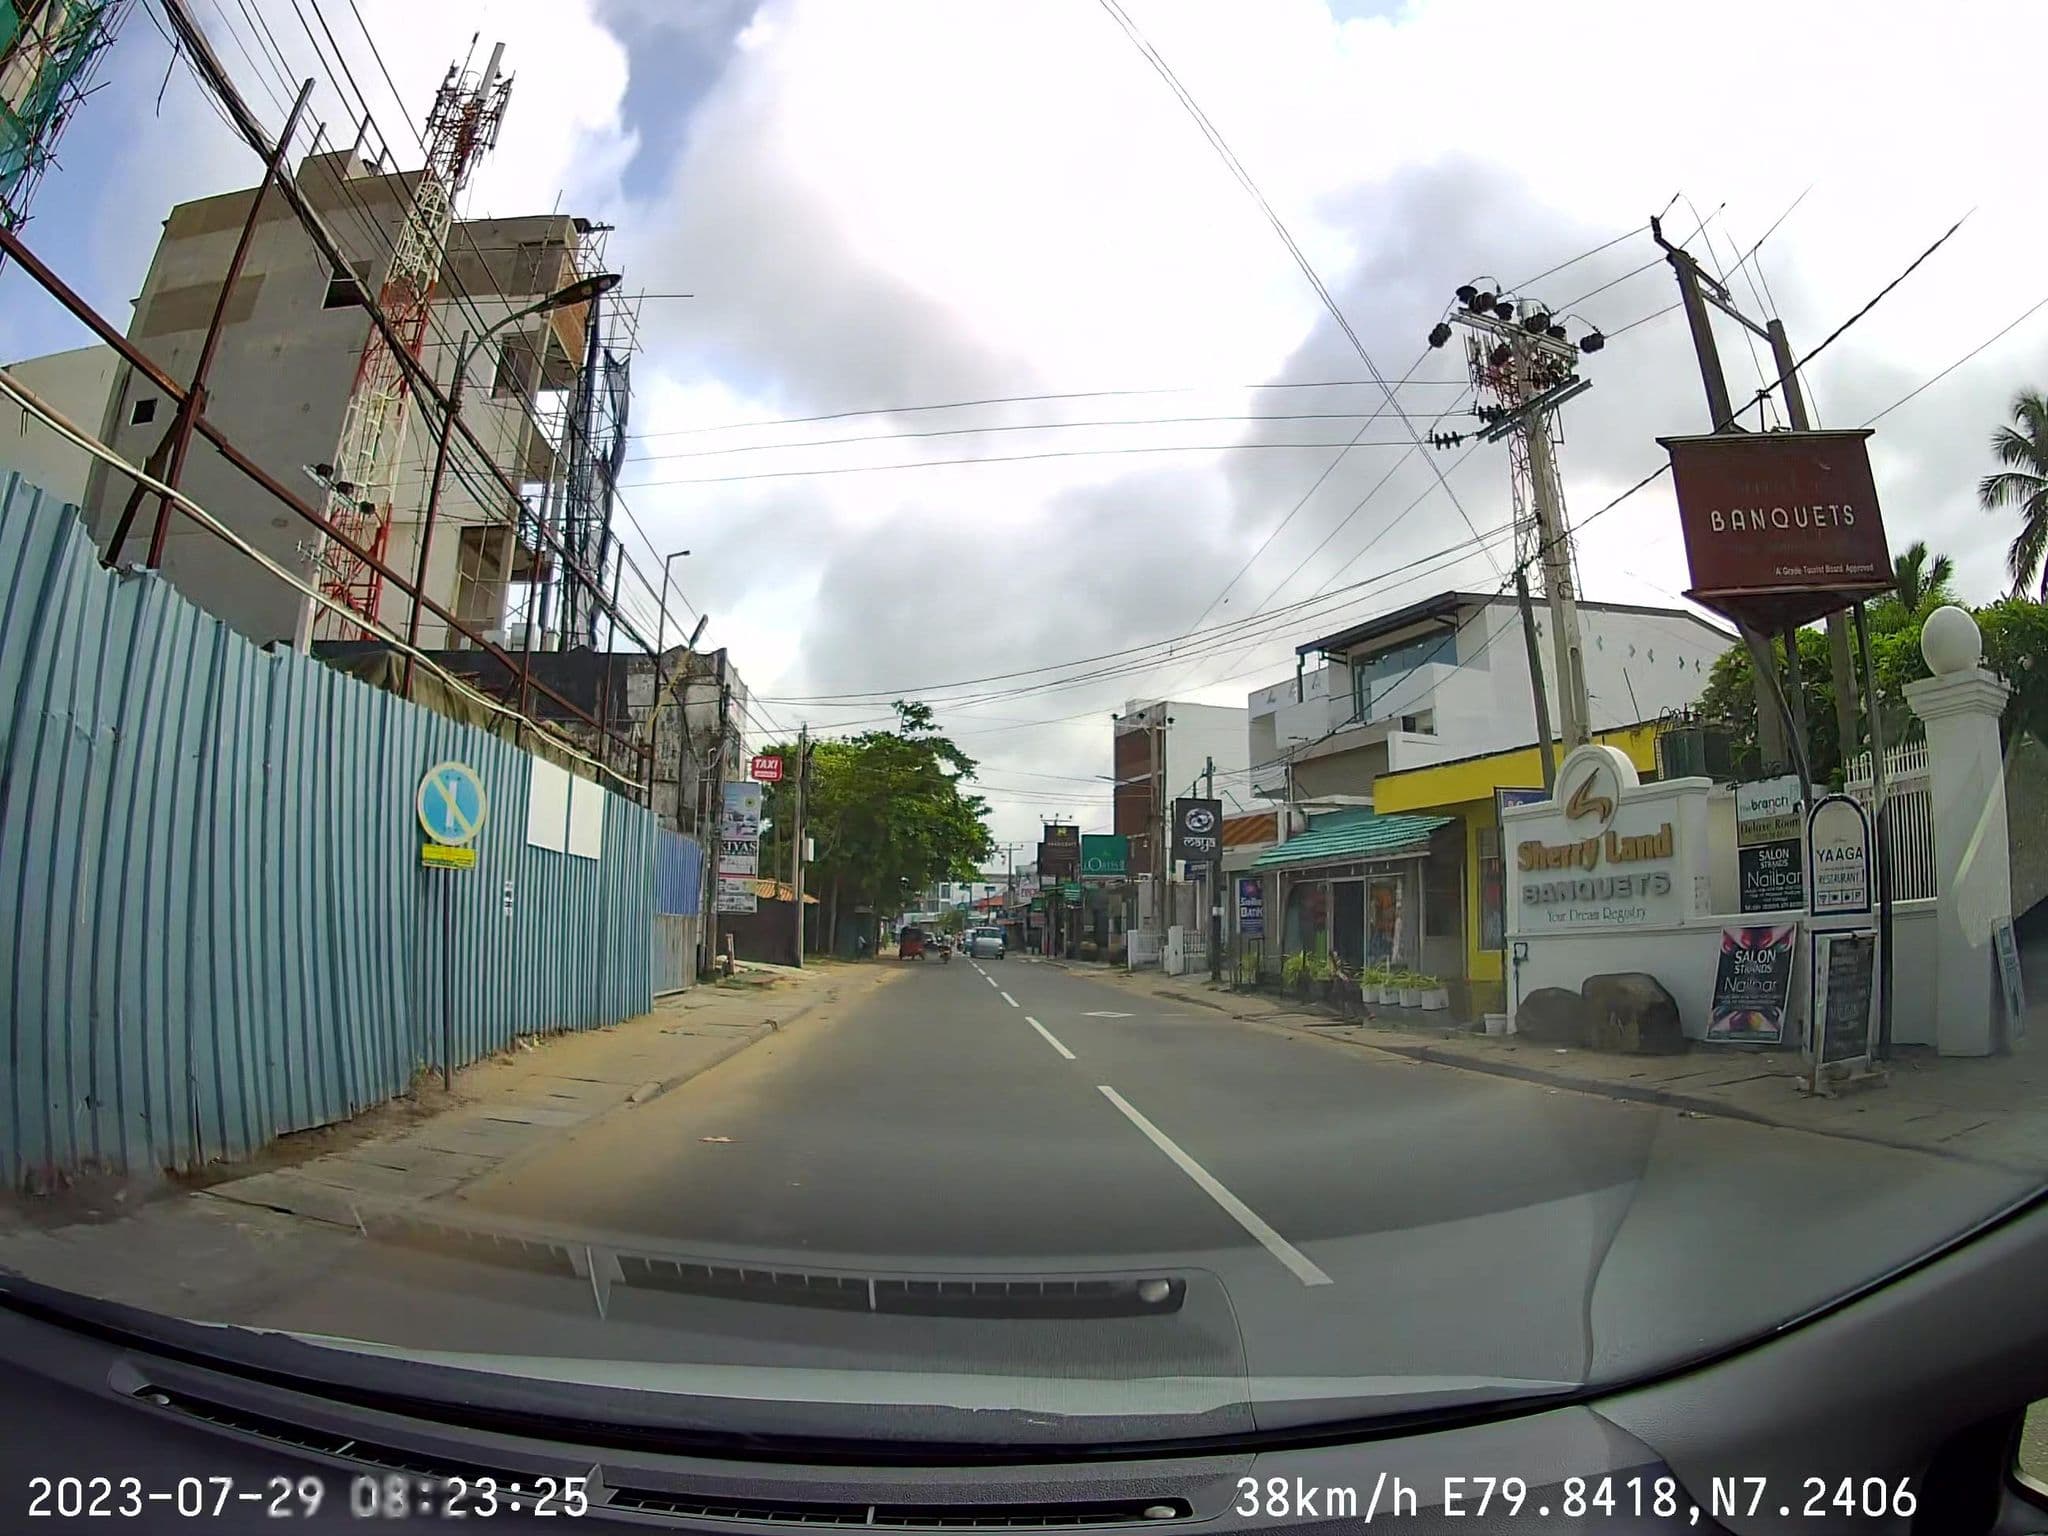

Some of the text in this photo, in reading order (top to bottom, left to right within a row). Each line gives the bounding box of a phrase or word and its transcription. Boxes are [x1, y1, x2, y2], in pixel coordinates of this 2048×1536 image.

[1710, 504, 1855, 532] BANQUETS
[755, 759, 778, 769] TAXI
[1751, 796, 1789, 811] branch
[1184, 837, 1216, 852] maya
[1518, 822, 1673, 872] Sherry Land
[1759, 848, 1790, 861] SALON
[1816, 846, 1864, 863] YAAGA
[1747, 870, 1802, 889] Nailbar
[1522, 872, 1671, 905] BANQUETS
[1547, 910, 1566, 923] Your
[1569, 909, 1600, 921] Dream
[1734, 950, 1777, 965] SALON
[1733, 964, 1773, 975] STRANDS
[1724, 977, 1777, 993] Nailbar
